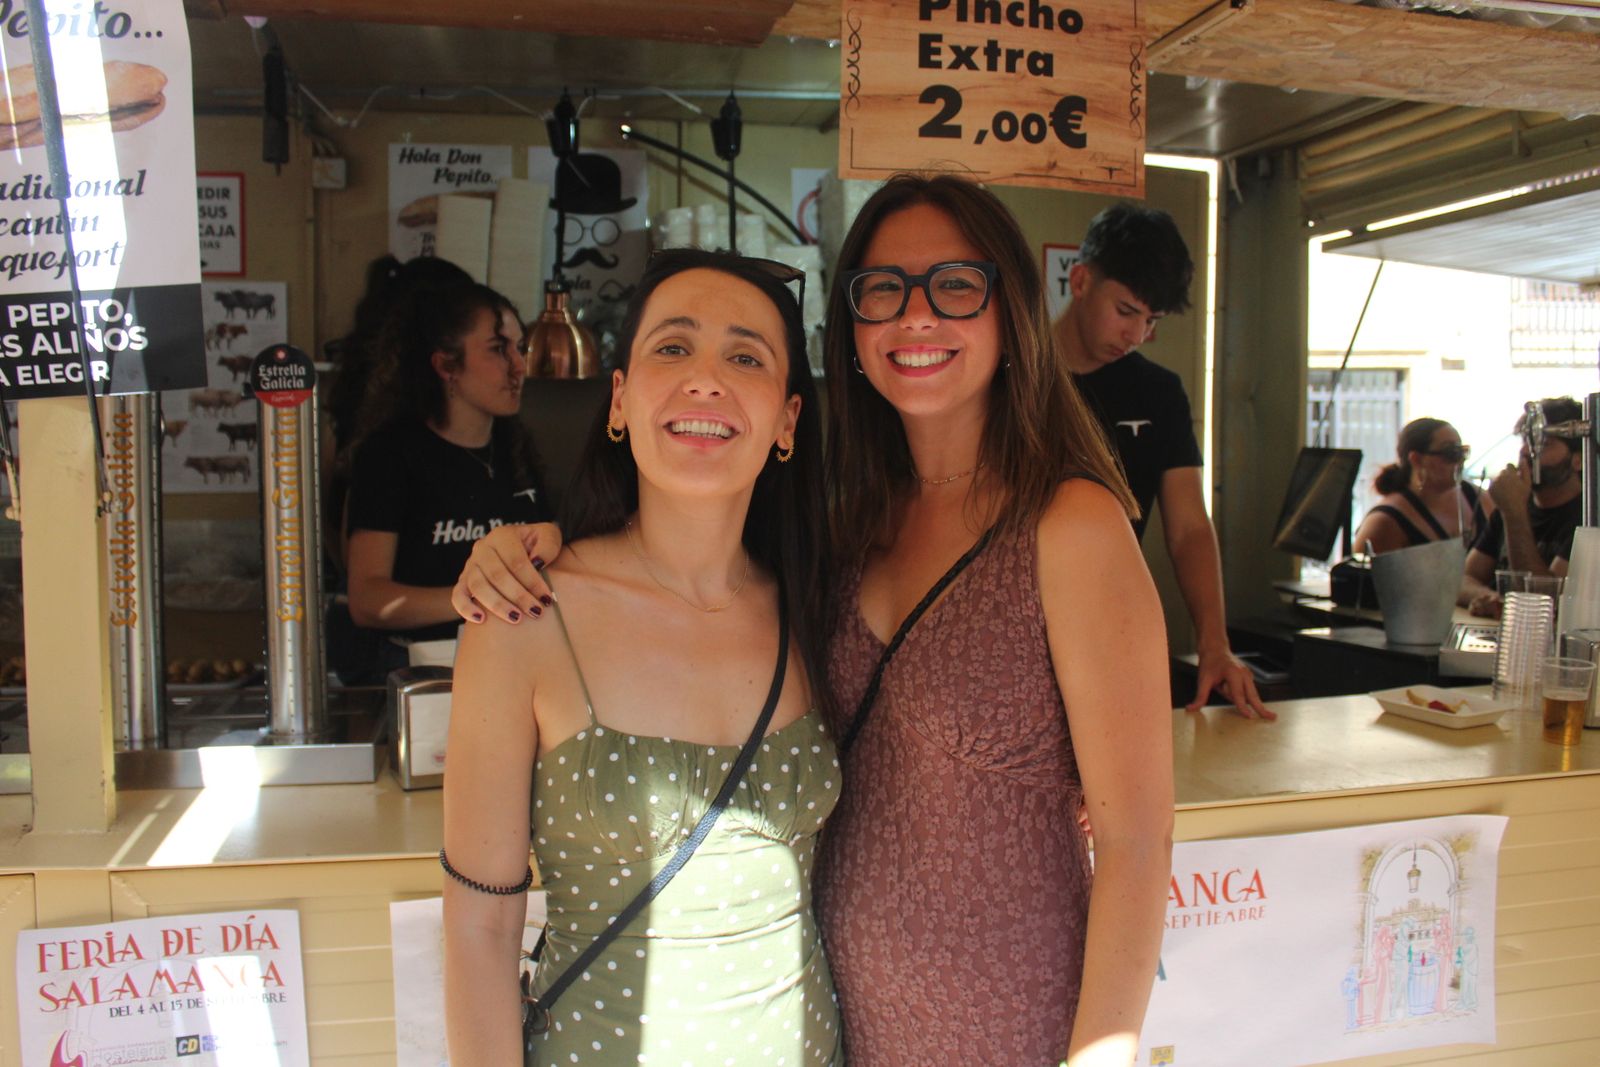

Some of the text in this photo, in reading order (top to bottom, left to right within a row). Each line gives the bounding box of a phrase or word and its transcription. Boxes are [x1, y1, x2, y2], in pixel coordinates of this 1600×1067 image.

[917, 0, 1084, 34] Pincho
[917, 33, 1055, 77] Extra
[917, 84, 1088, 149] 2,00€
[399, 147, 482, 164] Hola Don
[31, 323, 149, 357] ALIÑOS
[16, 361, 111, 386] ELEGR
[258, 364, 306, 377] Estrella
[260, 376, 305, 391] Galicia
[432, 518, 487, 545] Hola
[110, 520, 137, 628] Estrella
[275, 518, 304, 623] Estrella
[160, 926, 204, 957] DE
[220, 914, 280, 954] DÍA
[109, 1006, 133, 1018] DEL
[137, 1003, 145, 1015] 4
[149, 1002, 167, 1013] AL
[171, 1000, 184, 1011] 15
[187, 998, 204, 1009] DE
